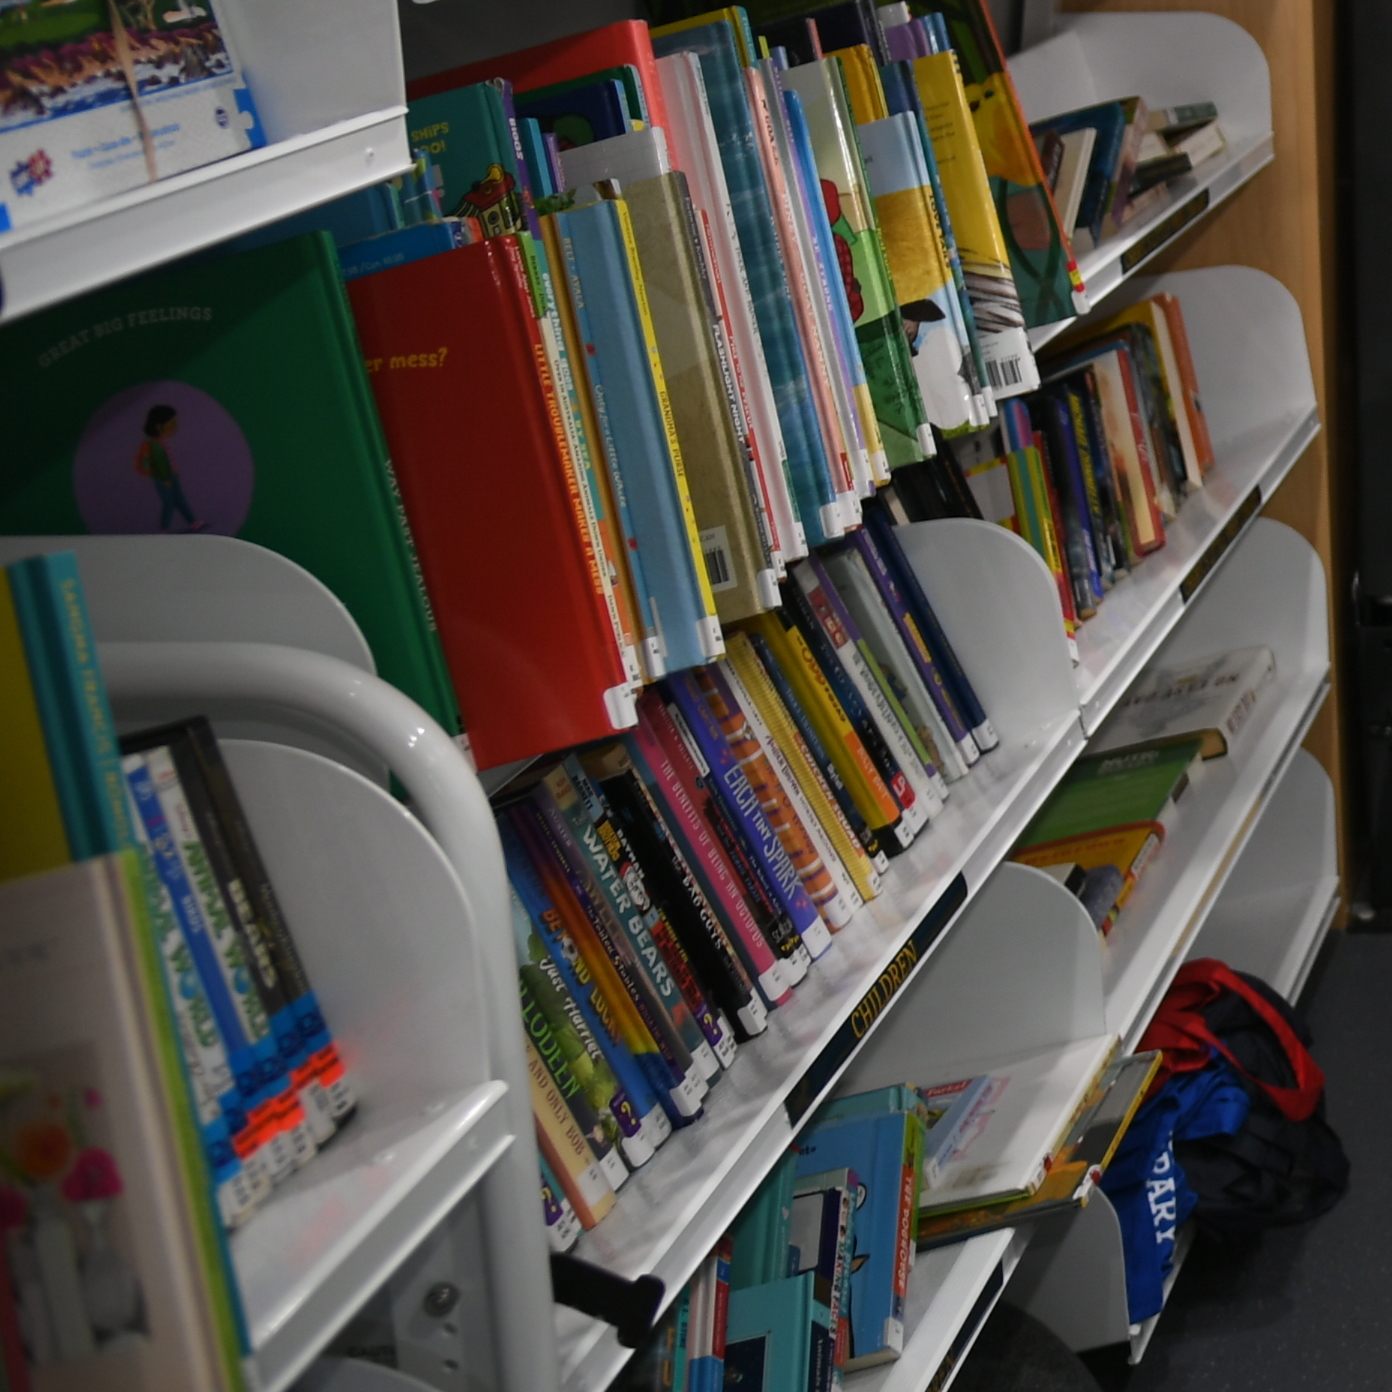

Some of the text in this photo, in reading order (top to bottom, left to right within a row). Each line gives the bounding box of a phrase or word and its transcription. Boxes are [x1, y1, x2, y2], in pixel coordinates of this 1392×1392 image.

[508, 117, 526, 161] BIGGS
[38, 306, 213, 367] GREAT BIG FEELINGS
[389, 347, 449, 371] mess?
[712, 324, 747, 445] FLASHLIGHT NIGHT
[533, 343, 553, 391] LITTLE
[547, 391, 578, 494] TROUBLEMAKER
[659, 760, 765, 949] THE BENEFITS BEING OCTOPUS
[724, 765, 804, 899] EACH TINY SPARK
[583, 824, 674, 998] WATER BEARS
[681, 878, 724, 950] BAD GUYS
[850, 939, 919, 1039] CHILDREN
[545, 1090, 568, 1124] ONLY
[565, 1126, 586, 1157] BOB
